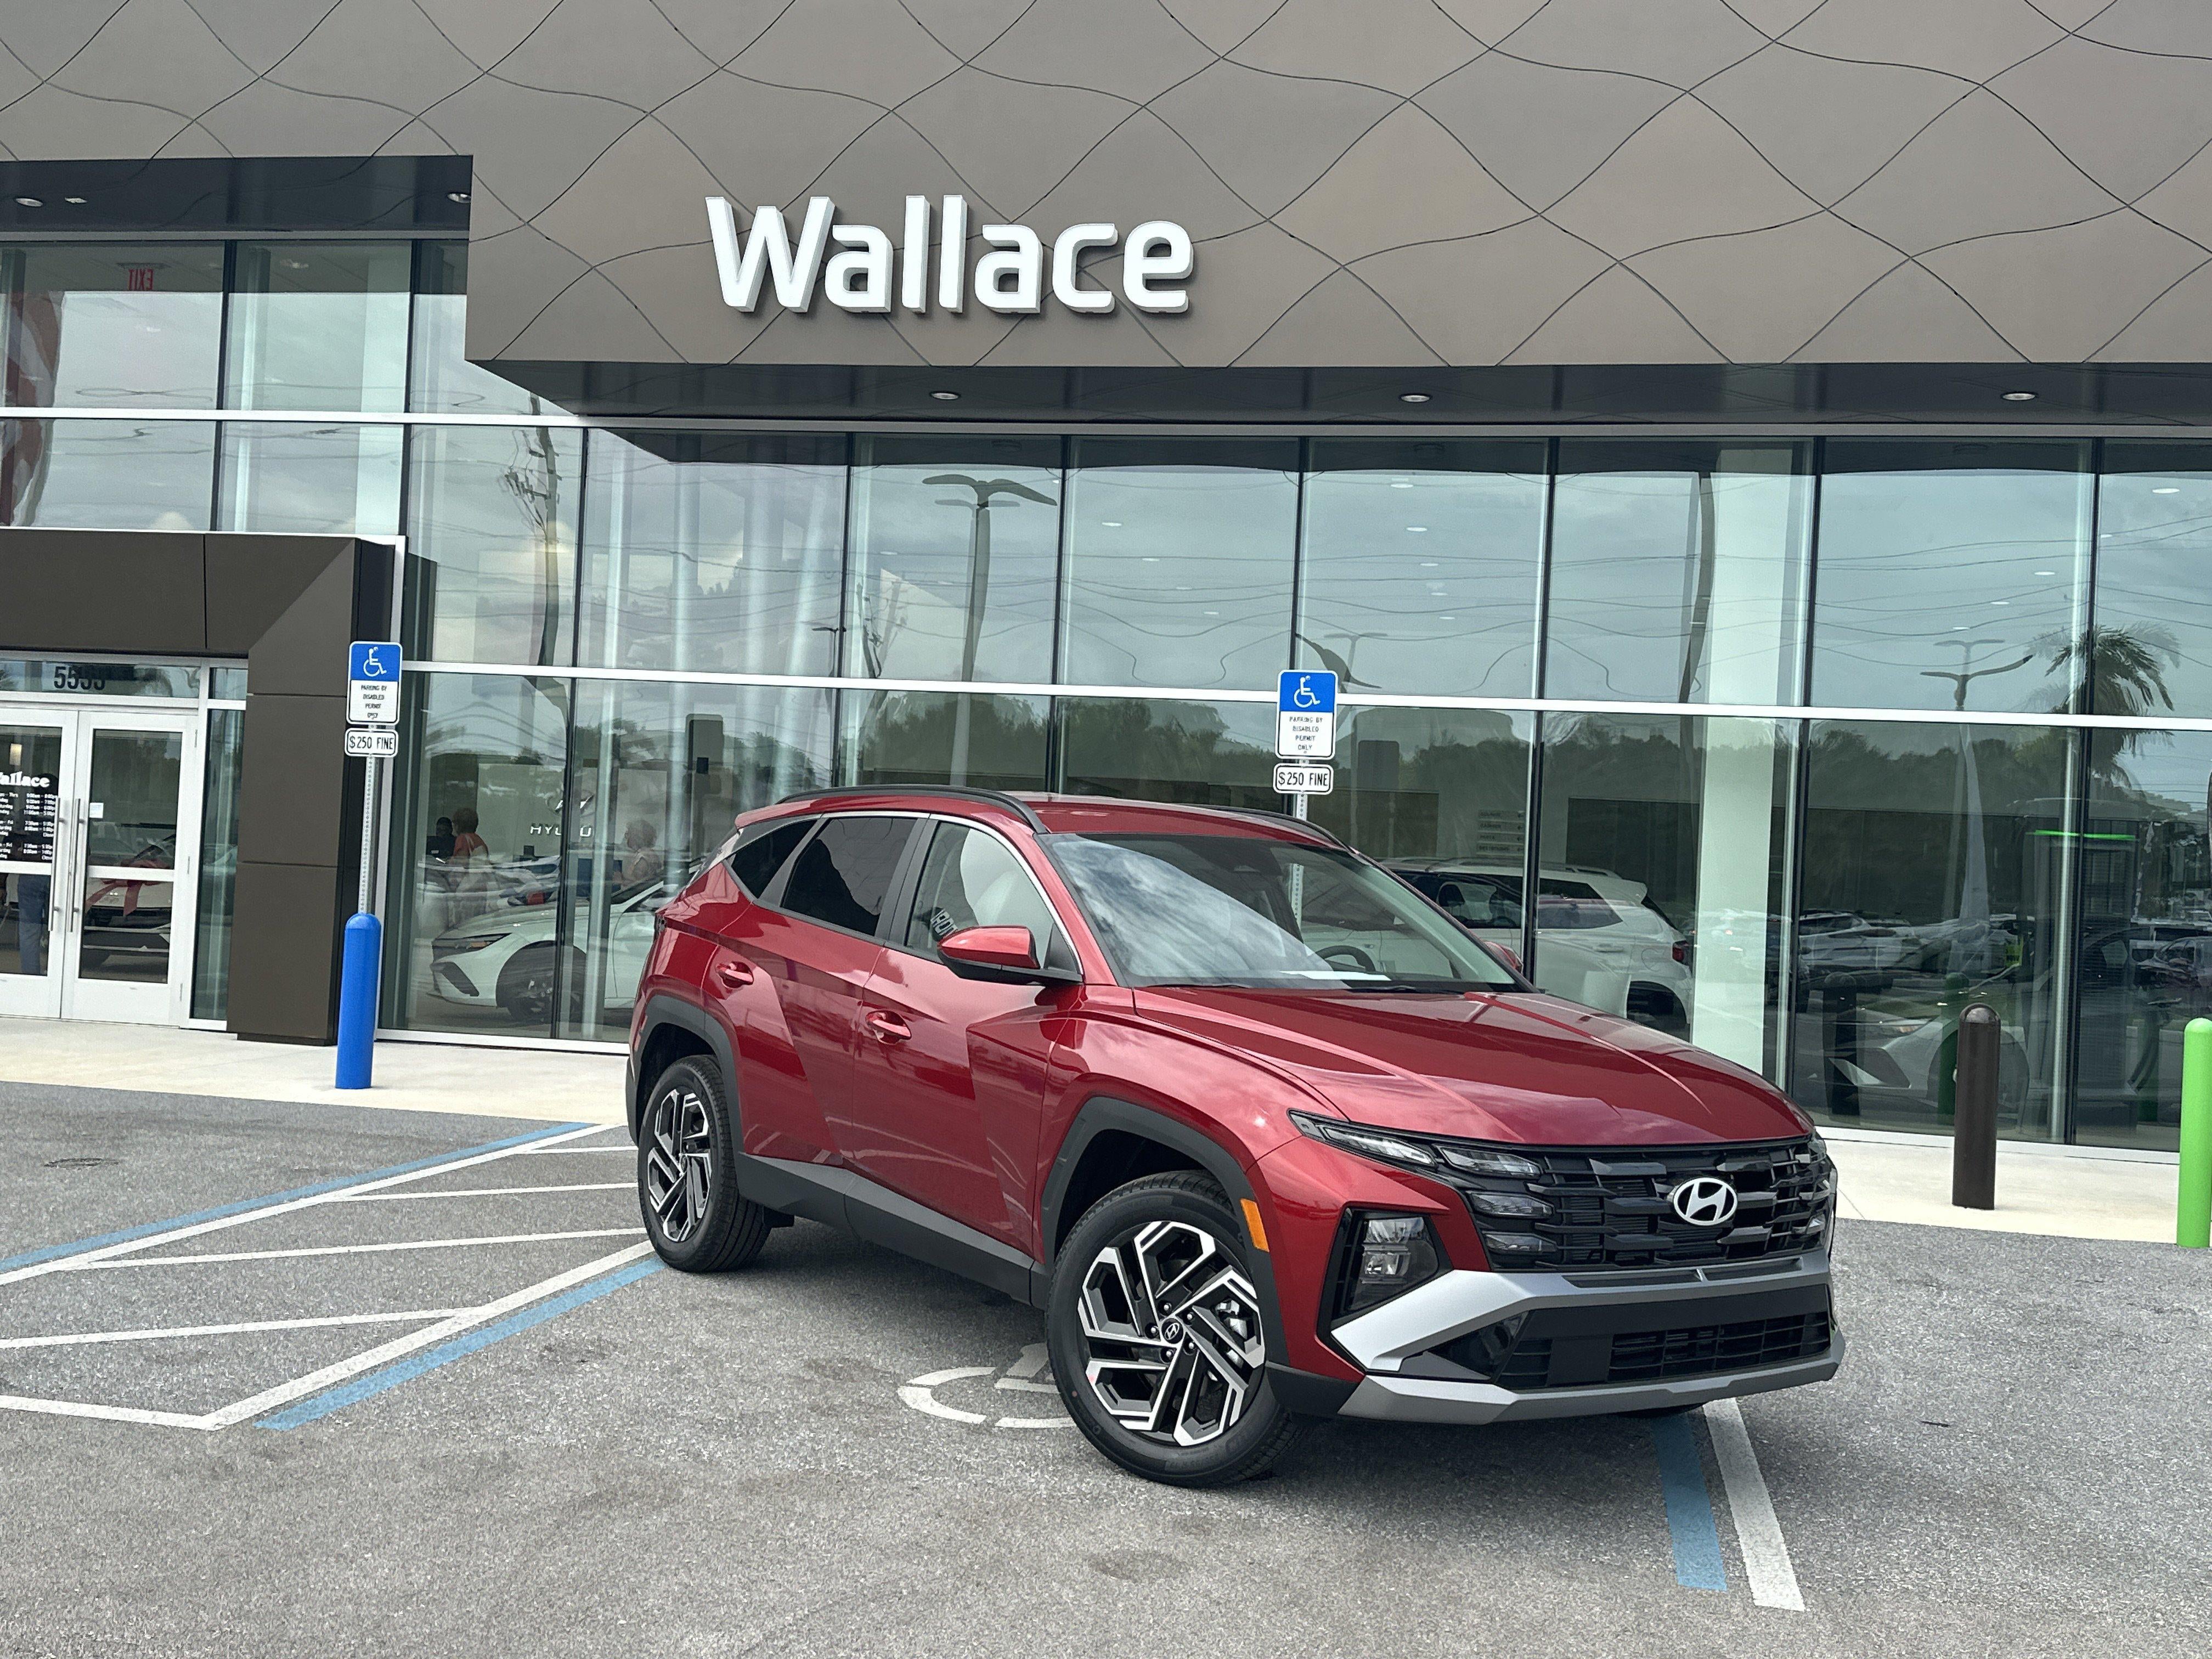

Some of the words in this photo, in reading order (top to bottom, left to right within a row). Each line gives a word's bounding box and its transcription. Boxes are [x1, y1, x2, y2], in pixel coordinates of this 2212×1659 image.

[706, 195, 1194, 313] Wallace
[349, 736, 373, 749] $250
[376, 737, 394, 750] FINE
[1278, 771, 1304, 786] $250
[1309, 772, 1329, 786] FINE
